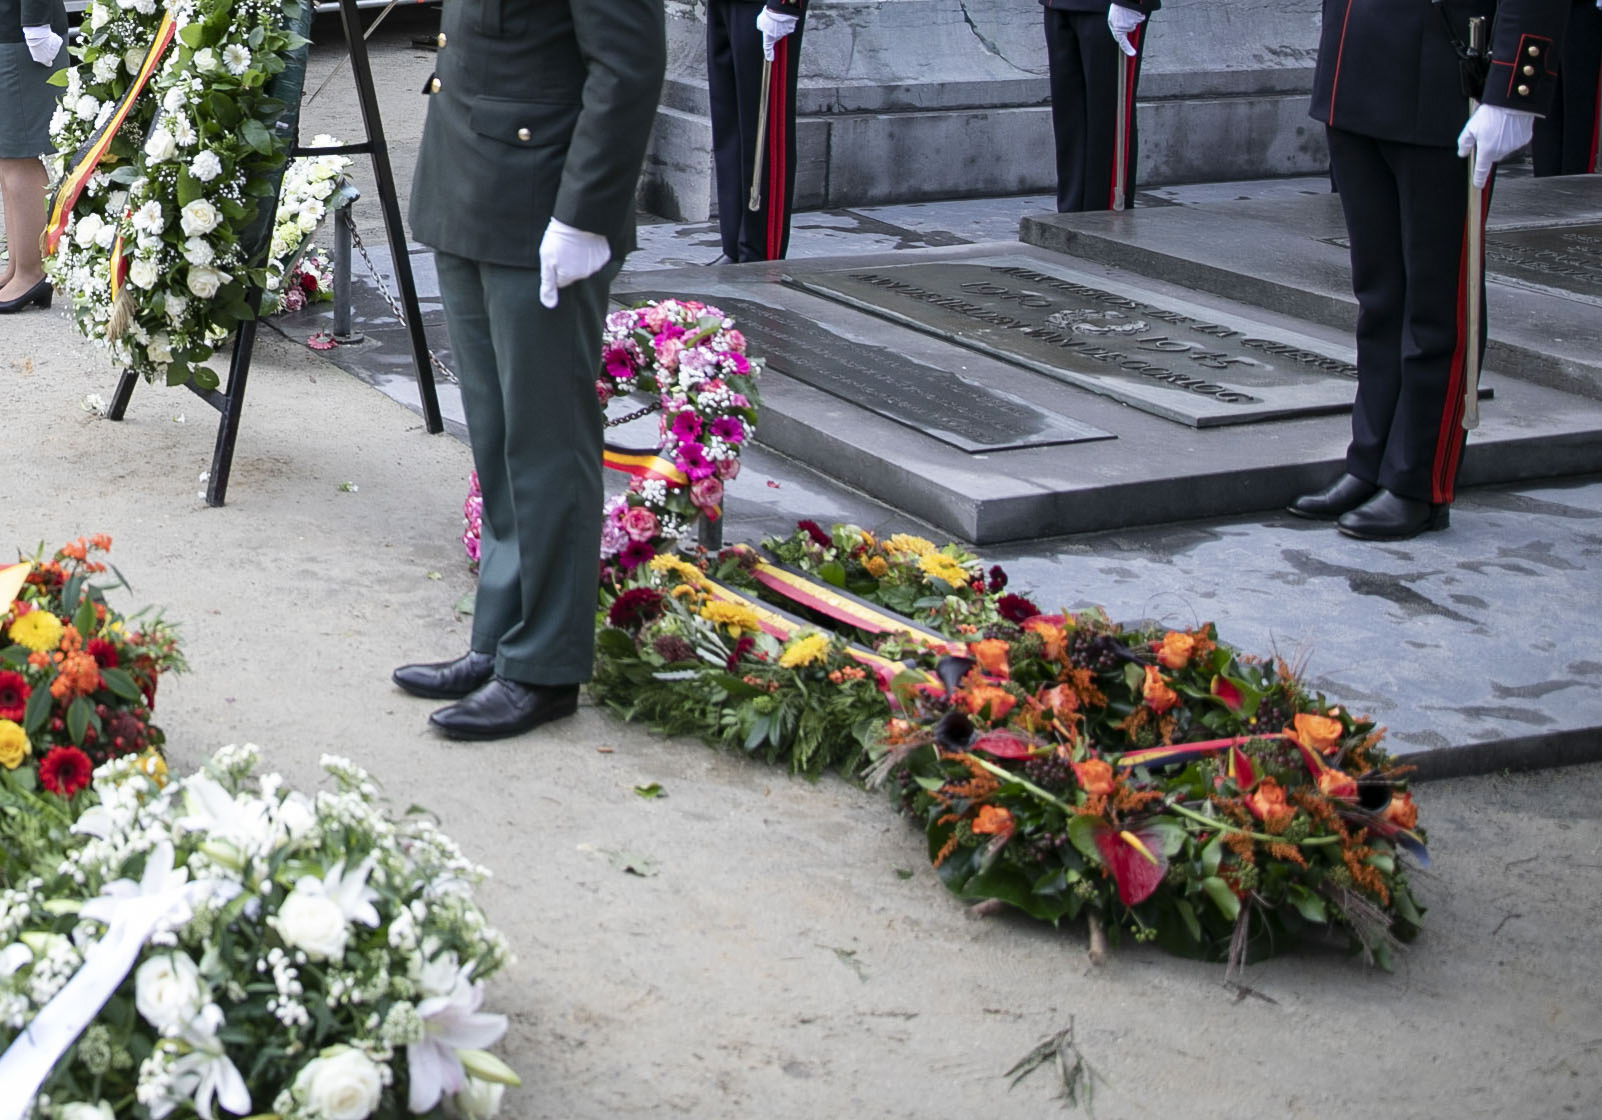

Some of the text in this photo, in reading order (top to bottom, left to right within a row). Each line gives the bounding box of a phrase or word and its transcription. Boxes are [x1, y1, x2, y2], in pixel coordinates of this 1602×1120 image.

[1193, 323, 1239, 338] LA
[1077, 346, 1128, 362] DE
[1119, 359, 1254, 404] OORLOG
